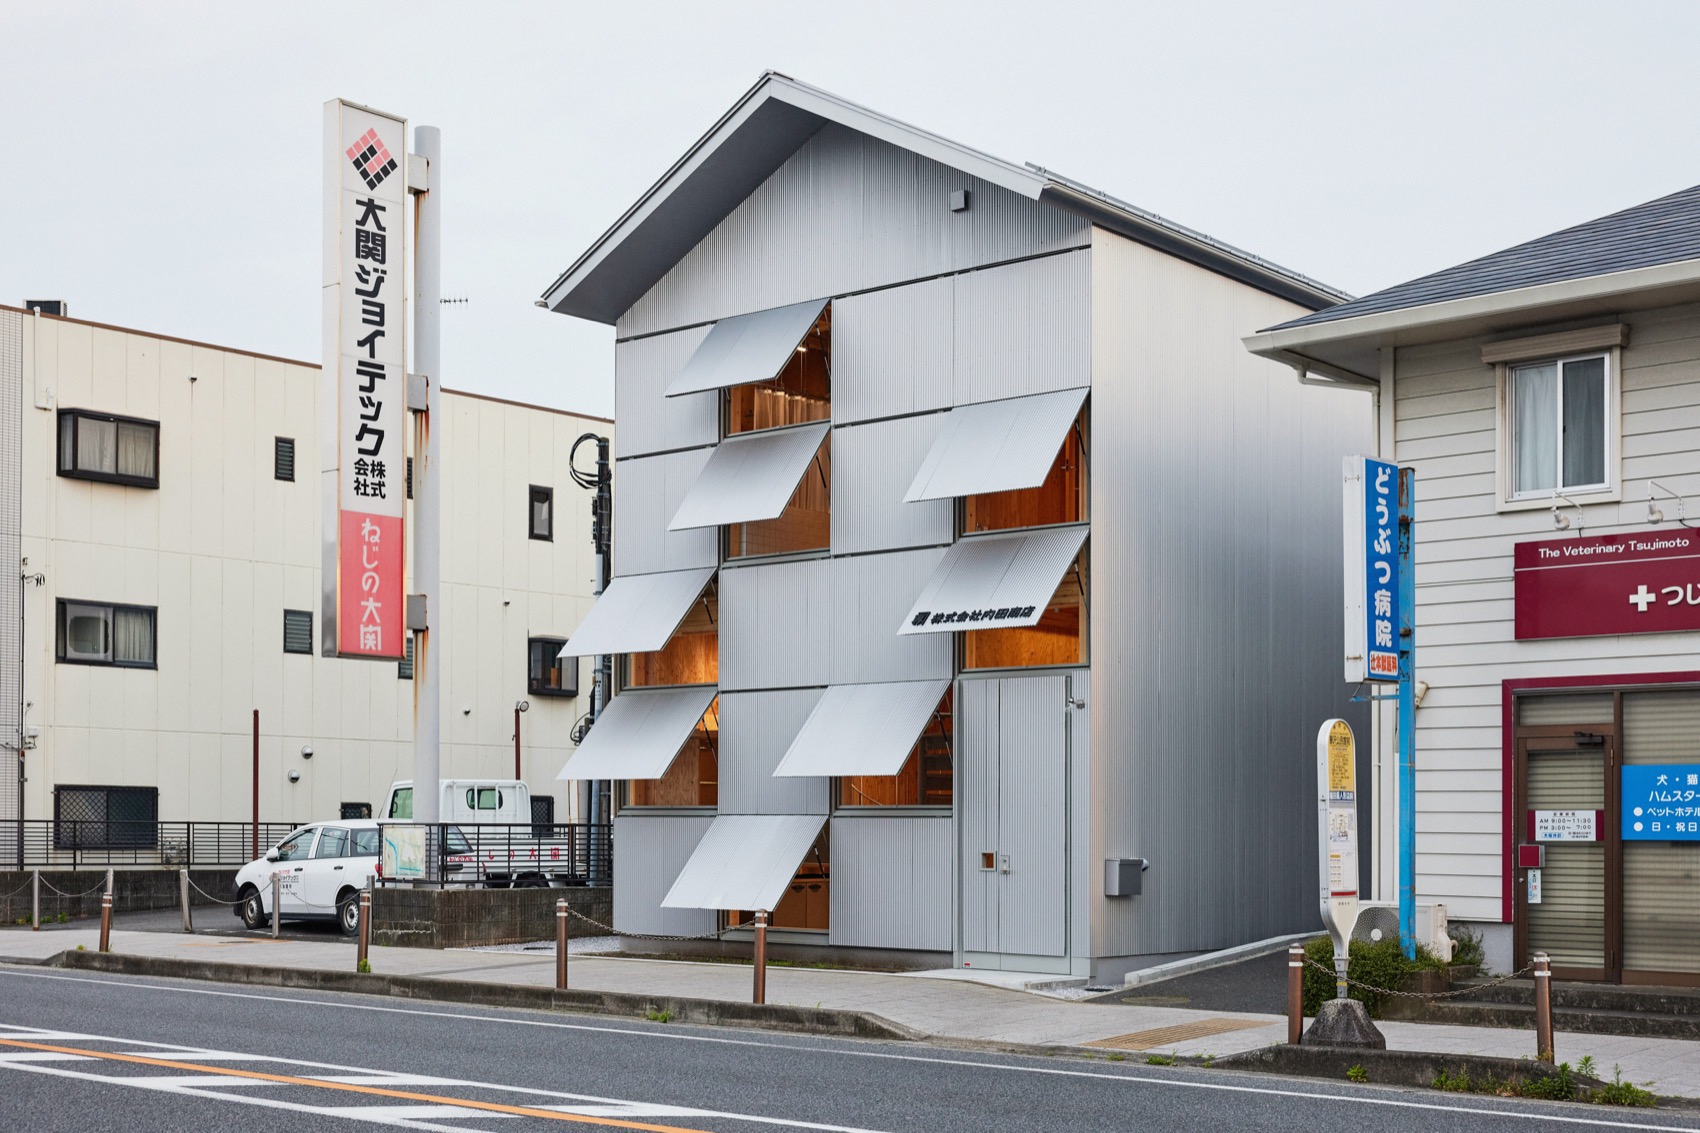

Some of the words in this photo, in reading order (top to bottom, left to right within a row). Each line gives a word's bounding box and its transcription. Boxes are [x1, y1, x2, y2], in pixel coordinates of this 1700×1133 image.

[354, 197, 387, 458] 大関ジョイテック
[353, 458, 387, 500] 株式会社
[1374, 466, 1393, 648] どうぶつ病院
[1538, 547, 1560, 559] The
[1563, 543, 1625, 557] Veterinary
[1628, 537, 1690, 552] Tsujimoto
[360, 517, 382, 652] ねじの大関
[930, 605, 1036, 625] 株式会社内田商店
[1656, 773, 1699, 786] 犬・猫
[1651, 821, 1698, 832] 日・祝日
